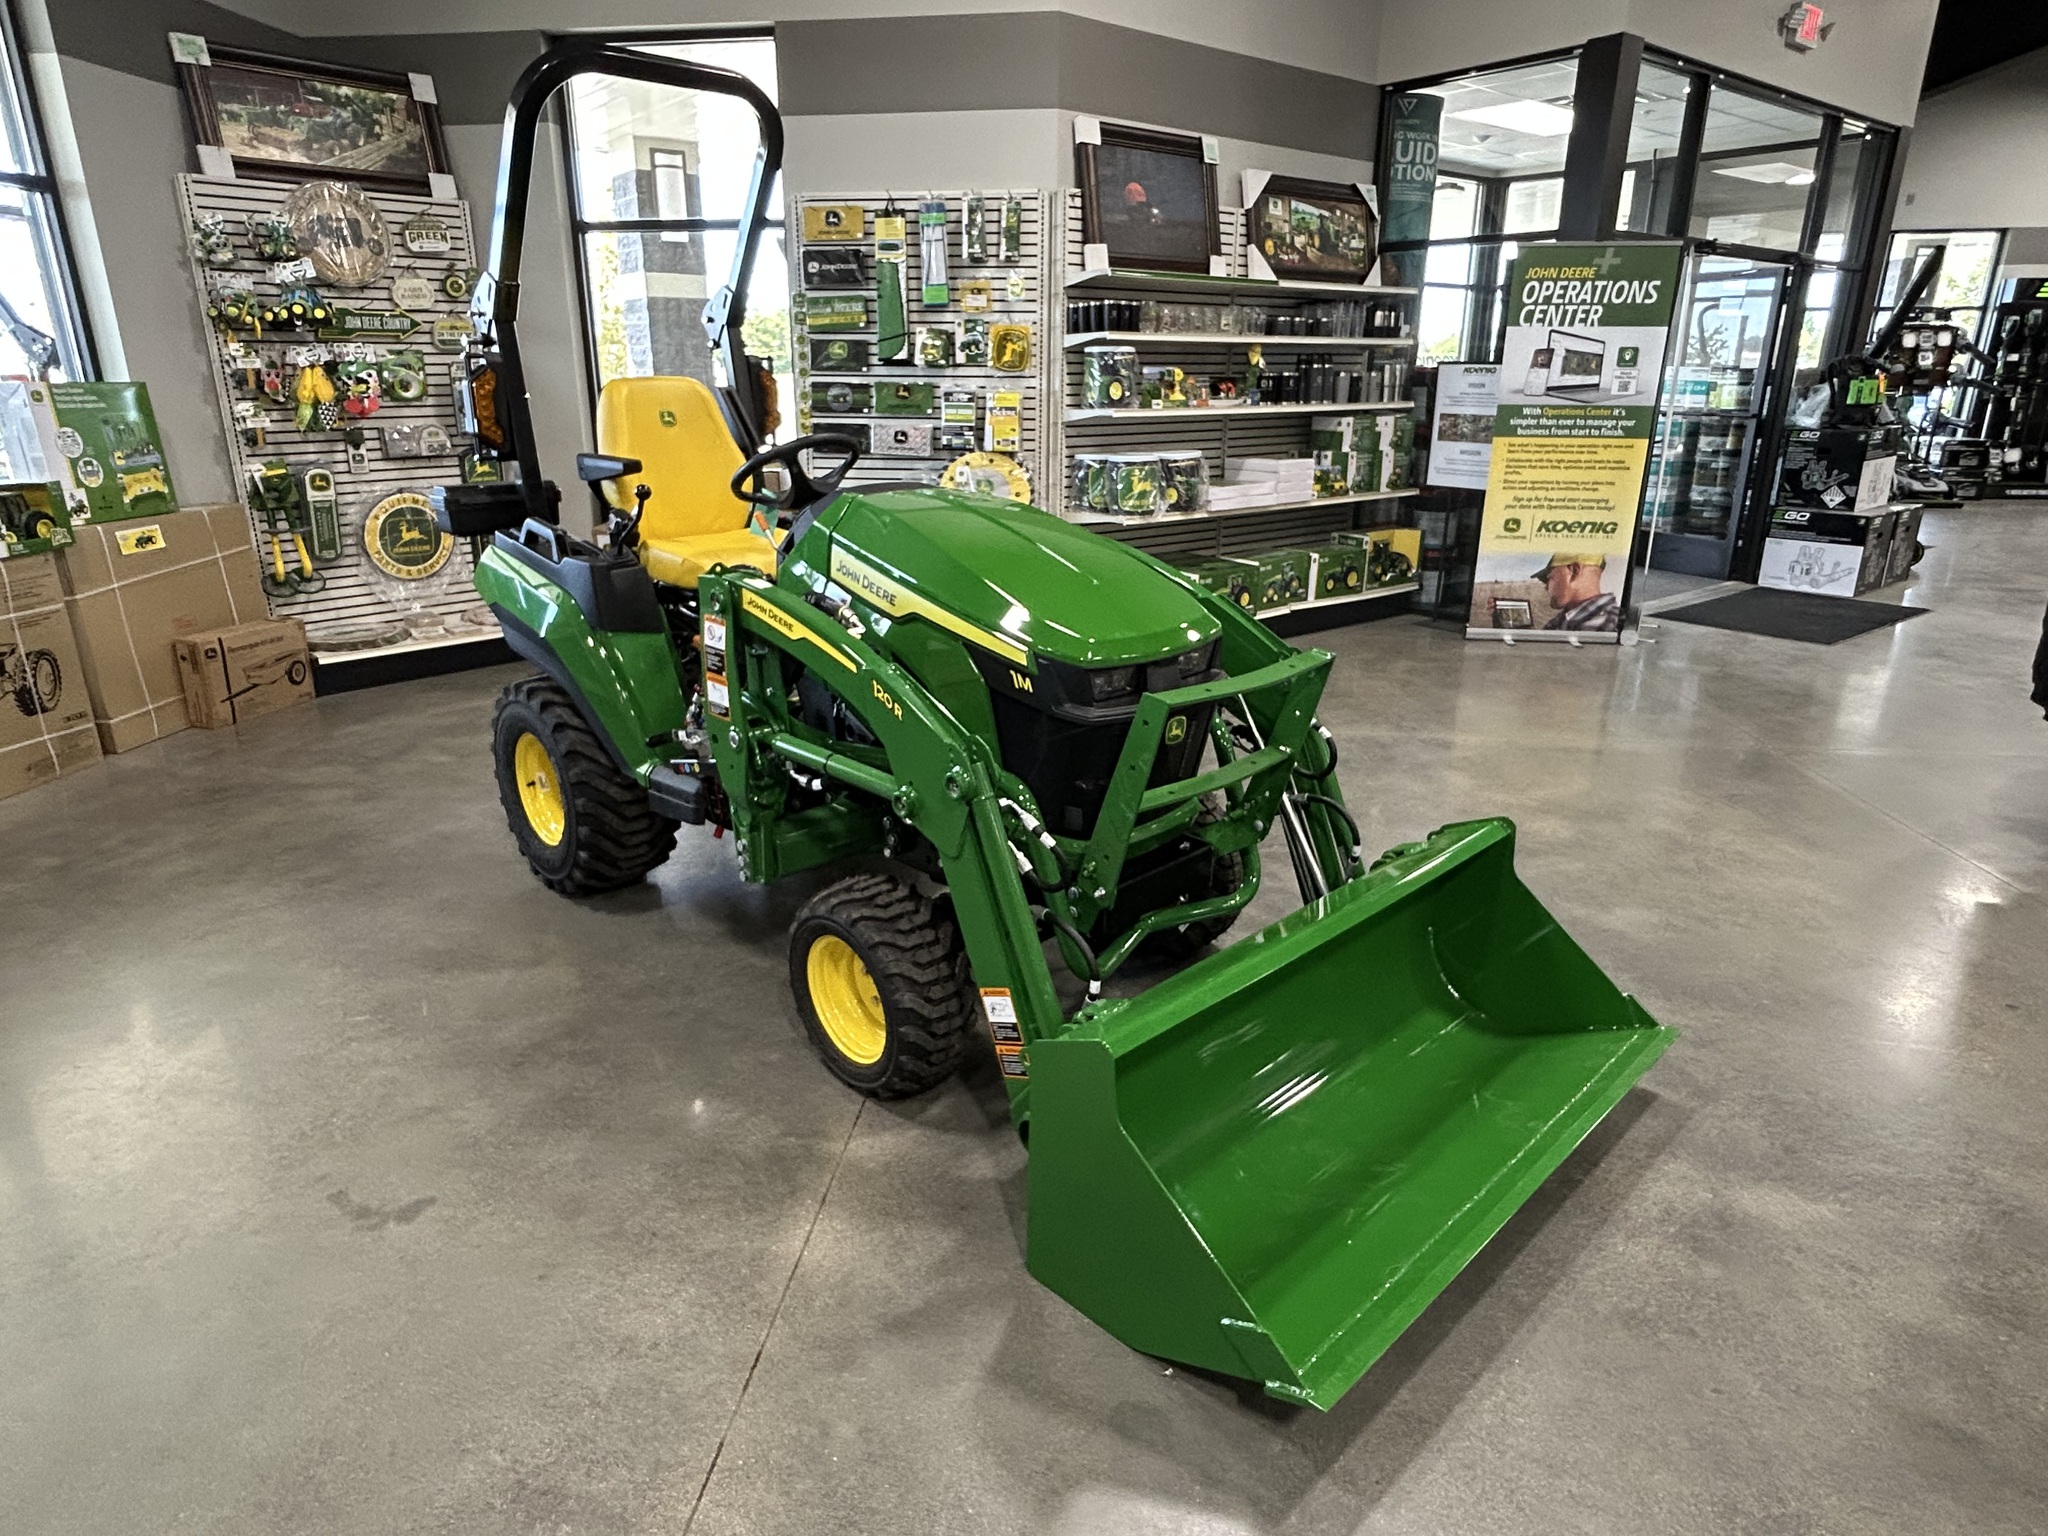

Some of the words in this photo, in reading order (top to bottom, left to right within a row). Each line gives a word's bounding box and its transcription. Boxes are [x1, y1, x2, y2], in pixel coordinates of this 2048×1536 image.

[1391, 164, 1434, 181] TION
[409, 231, 448, 243] GREEN
[1525, 267, 1557, 279] JOHN
[1560, 267, 1597, 279] DEERE
[1522, 280, 1661, 304] OPERATIONS
[344, 316, 361, 328] JOHN
[362, 316, 382, 329] DEERE
[383, 316, 410, 330] COUNTRY
[1519, 305, 1603, 327] CENTER
[1522, 408, 1541, 416] With
[1543, 408, 1584, 416] Operations
[1586, 408, 1611, 416] Center
[1613, 408, 1626, 416] it's
[1510, 418, 1538, 427] simpler
[1540, 418, 1557, 426] than
[1576, 418, 1585, 426] to
[1586, 420, 1616, 428] manage
[1618, 420, 1636, 428] your
[1517, 427, 1550, 436] business
[1550, 427, 1570, 436] from
[1571, 428, 1590, 436] start
[1591, 428, 1600, 436] to
[1600, 428, 1625, 436] finish.
[1773, 508, 1810, 520] EGO
[836, 560, 860, 586] JOHN
[862, 574, 897, 607] DEERE
[748, 596, 768, 615] JOHN
[768, 608, 794, 632] DEERE
[1010, 669, 1034, 693] 1M
[871, 679, 893, 710] 120
[894, 705, 904, 721] R
